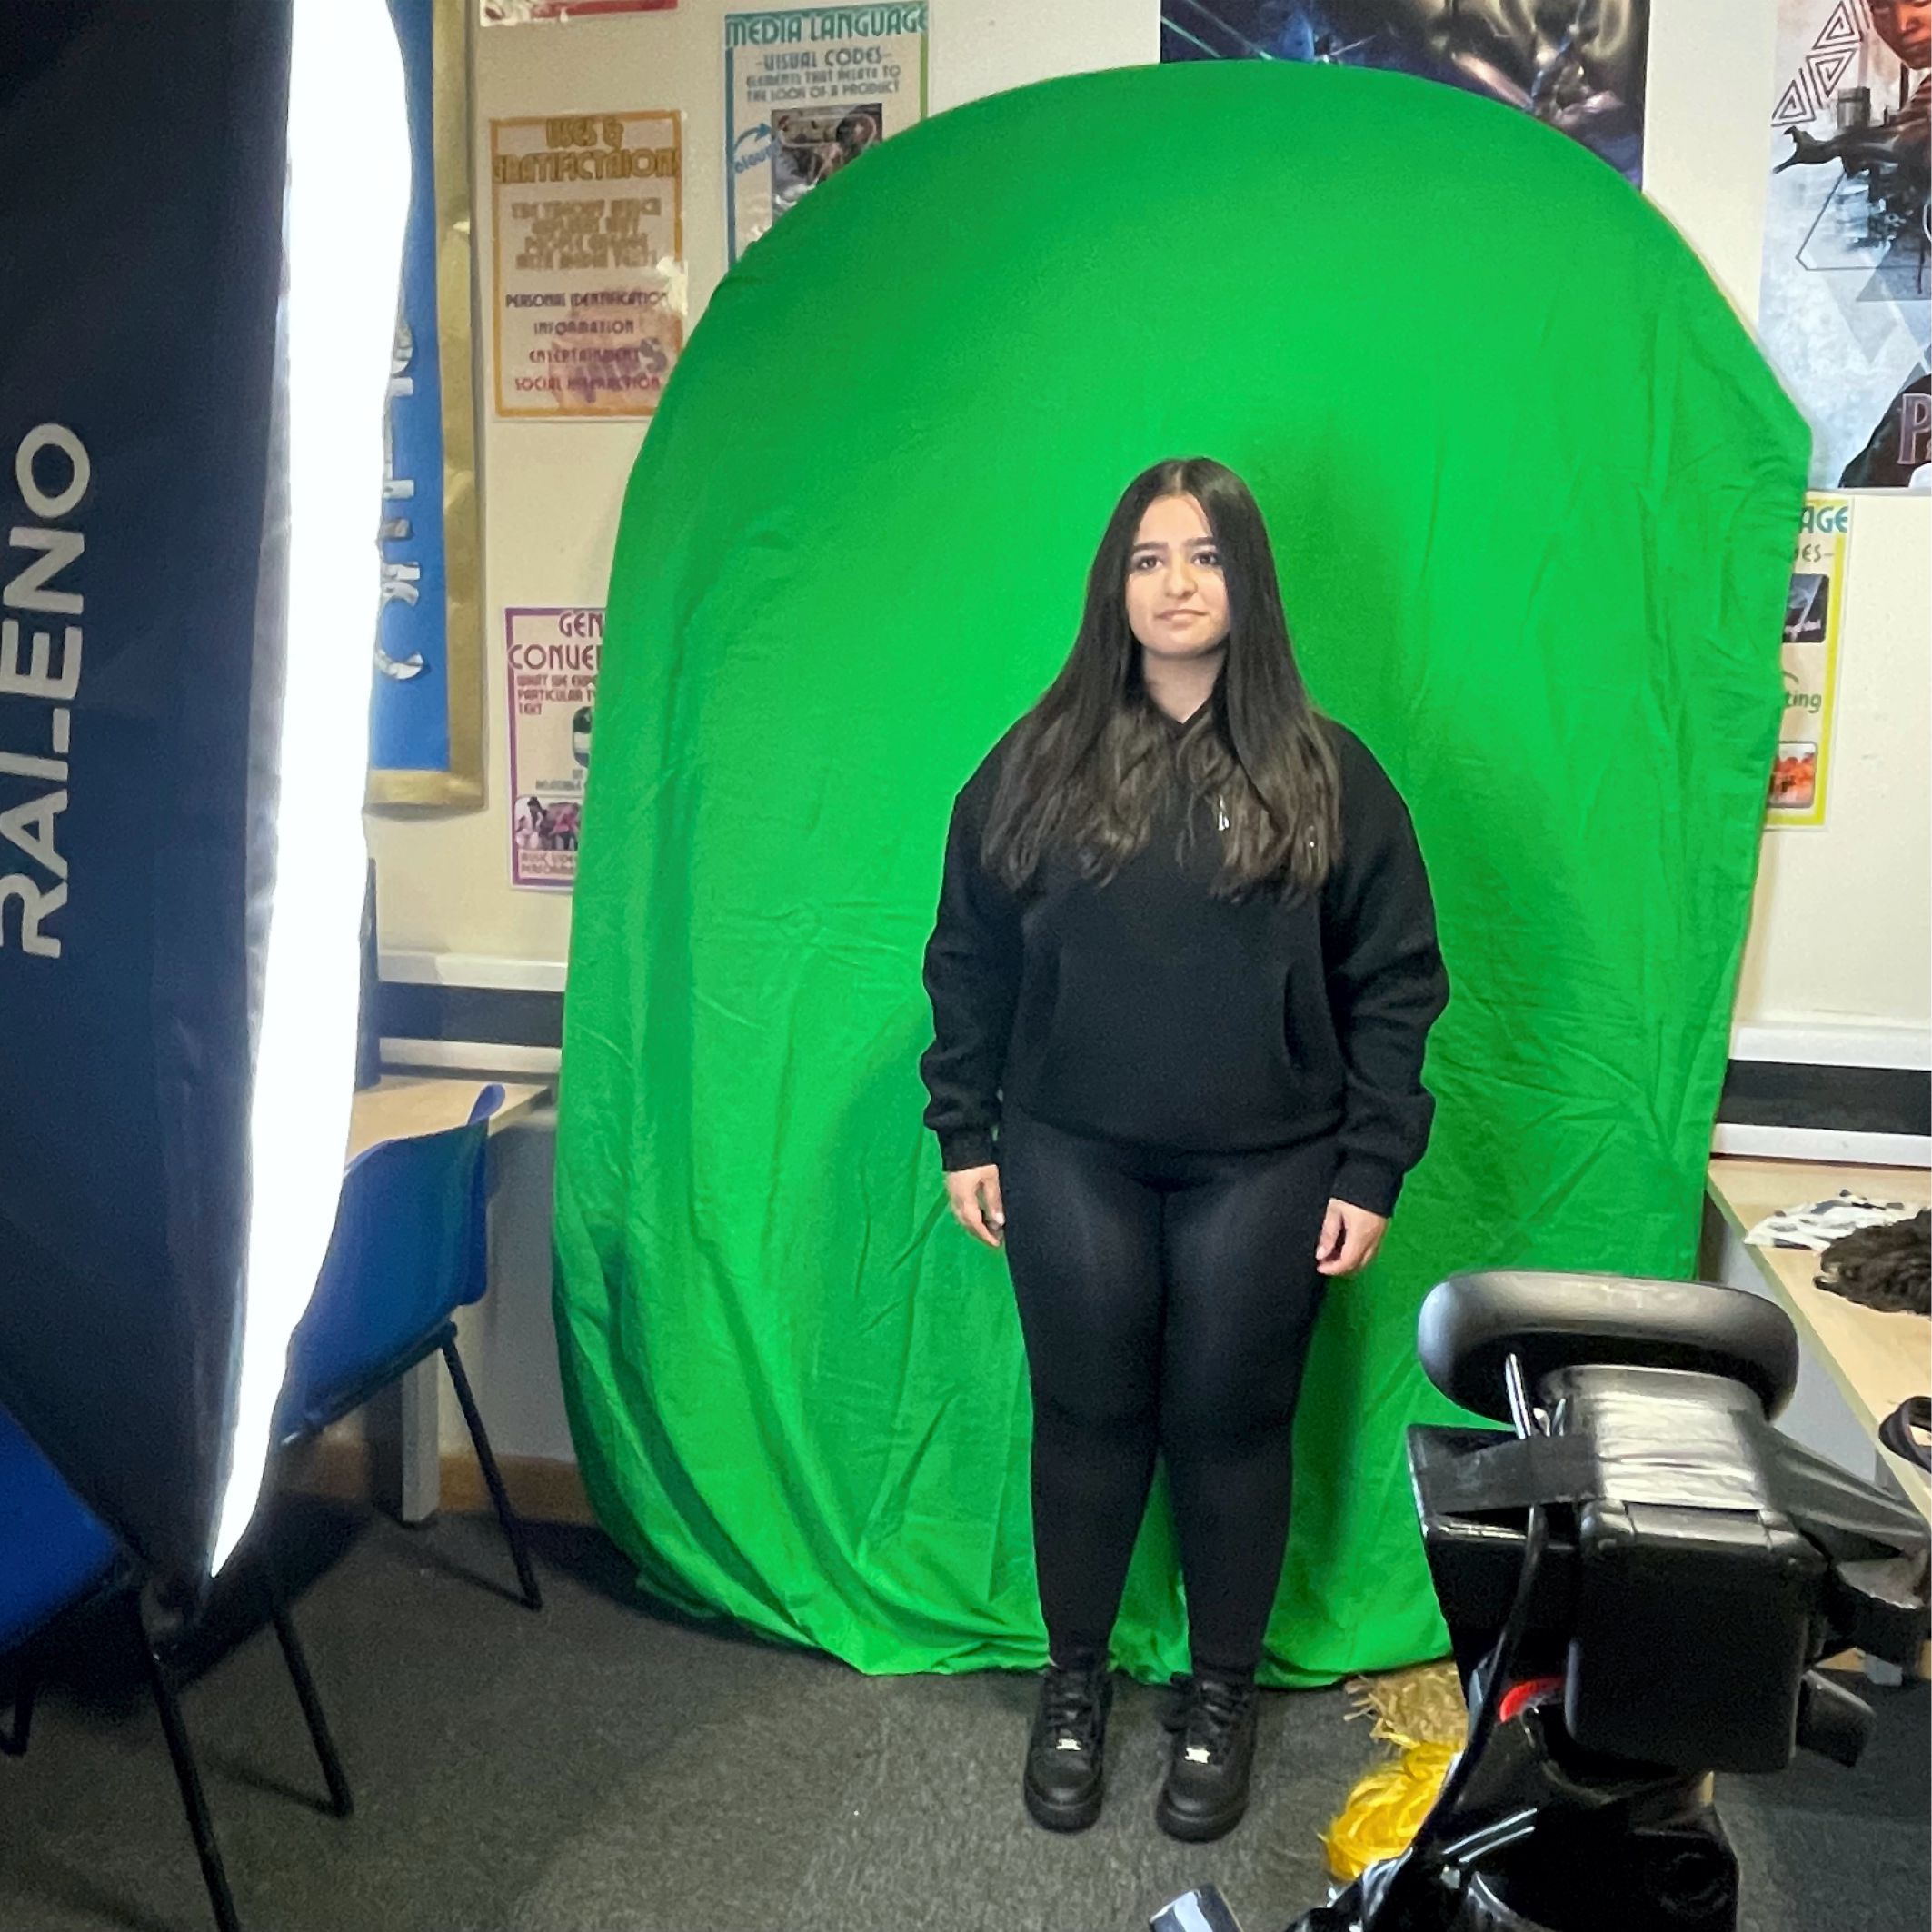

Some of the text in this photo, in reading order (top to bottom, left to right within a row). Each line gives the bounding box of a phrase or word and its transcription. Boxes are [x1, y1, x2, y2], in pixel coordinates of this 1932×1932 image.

[726, 7, 928, 46] MEDIA LANGUAGE
[883, 65, 901, 78] TO
[534, 320, 634, 335] INFORMATION
[515, 377, 563, 392] SOCIAL
[1898, 393, 1932, 464] P
[0, 423, 91, 958] RALENO
